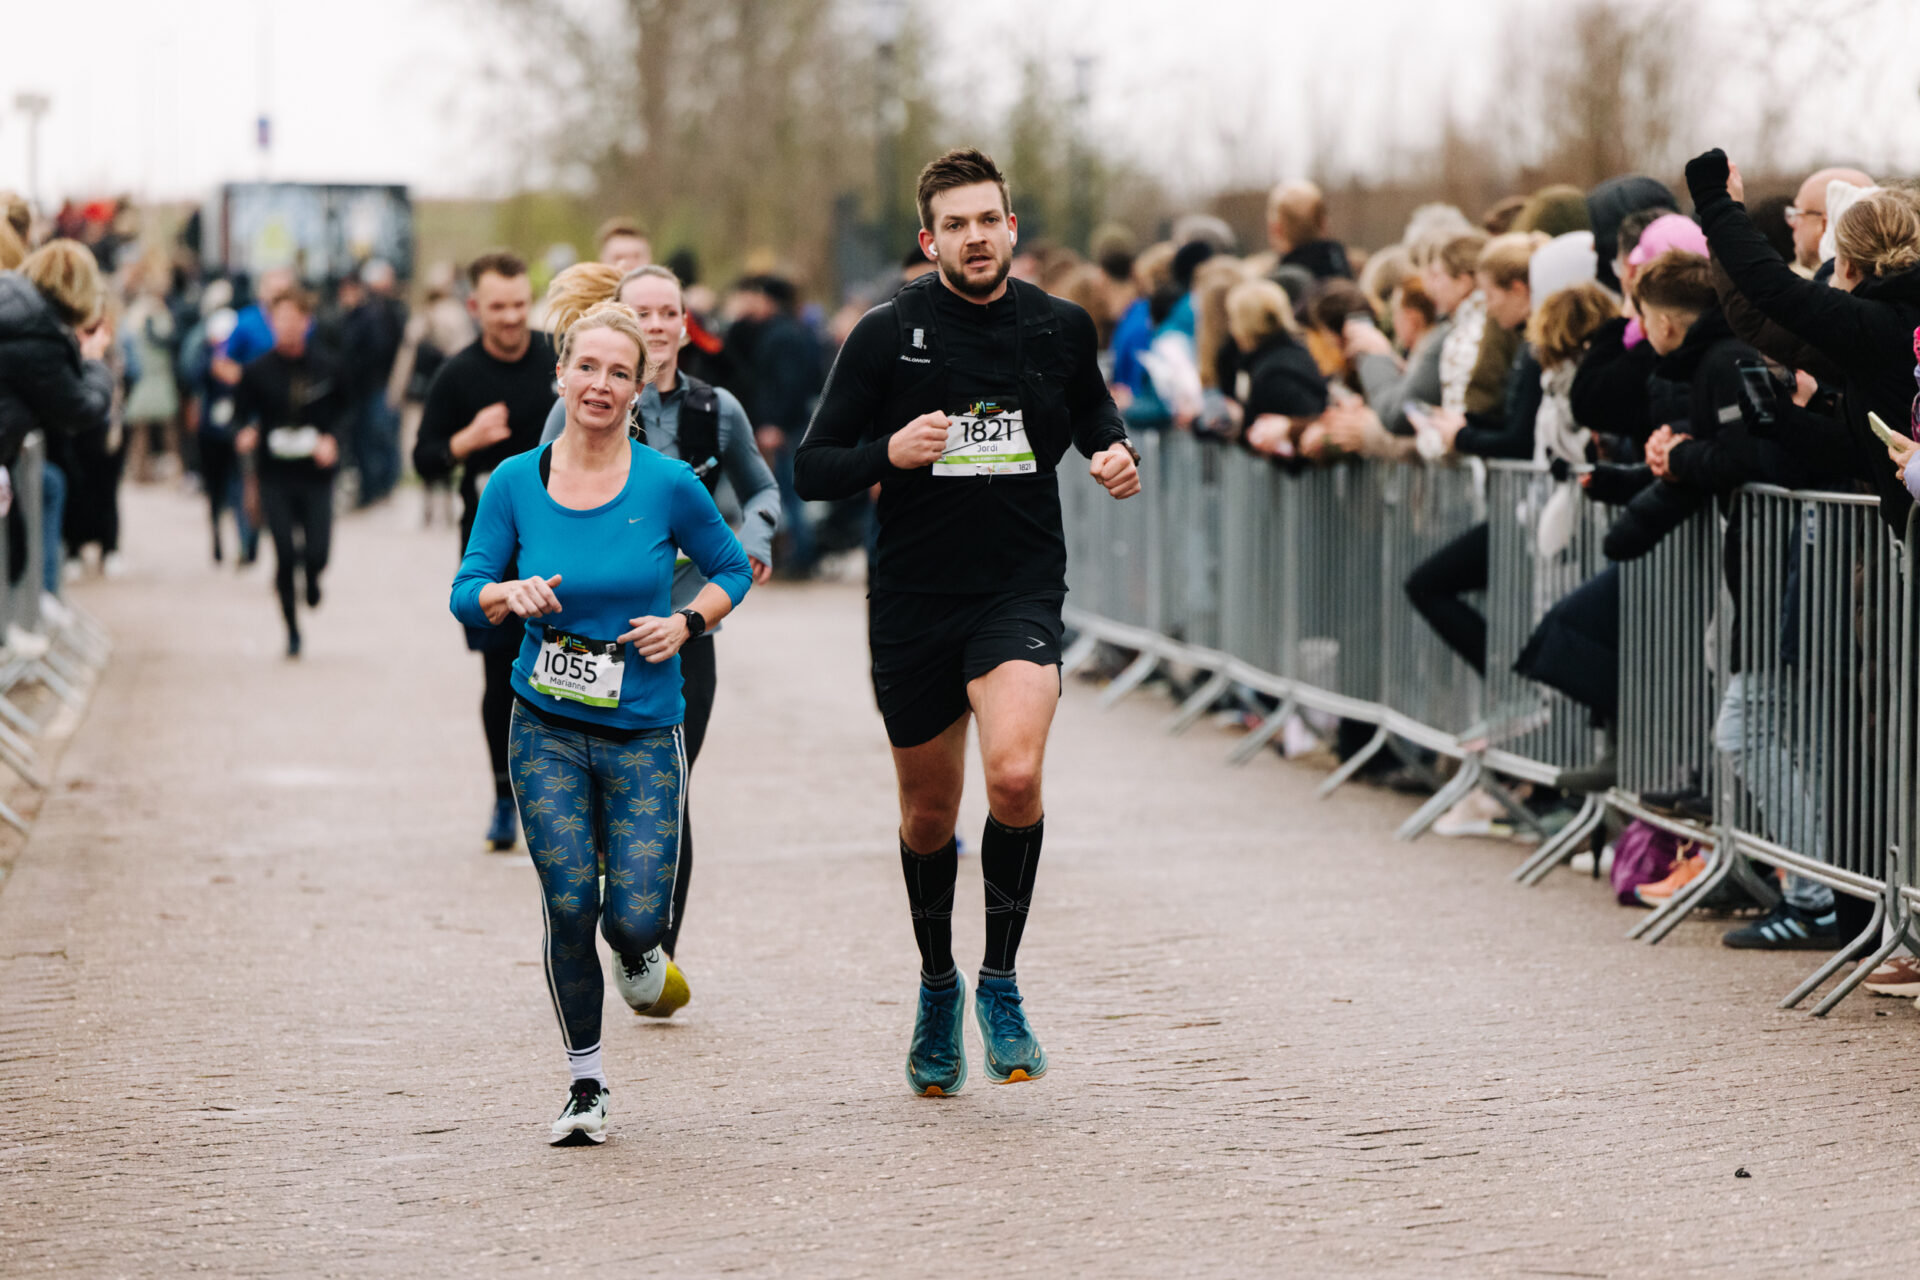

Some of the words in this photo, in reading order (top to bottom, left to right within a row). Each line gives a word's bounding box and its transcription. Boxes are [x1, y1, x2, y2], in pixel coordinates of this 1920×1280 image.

[961, 419, 1012, 443] 1821
[977, 444, 998, 453] Jordi
[1018, 463, 1031, 471] 1821
[544, 650, 597, 684] 1055
[549, 676, 587, 692] Marianne
